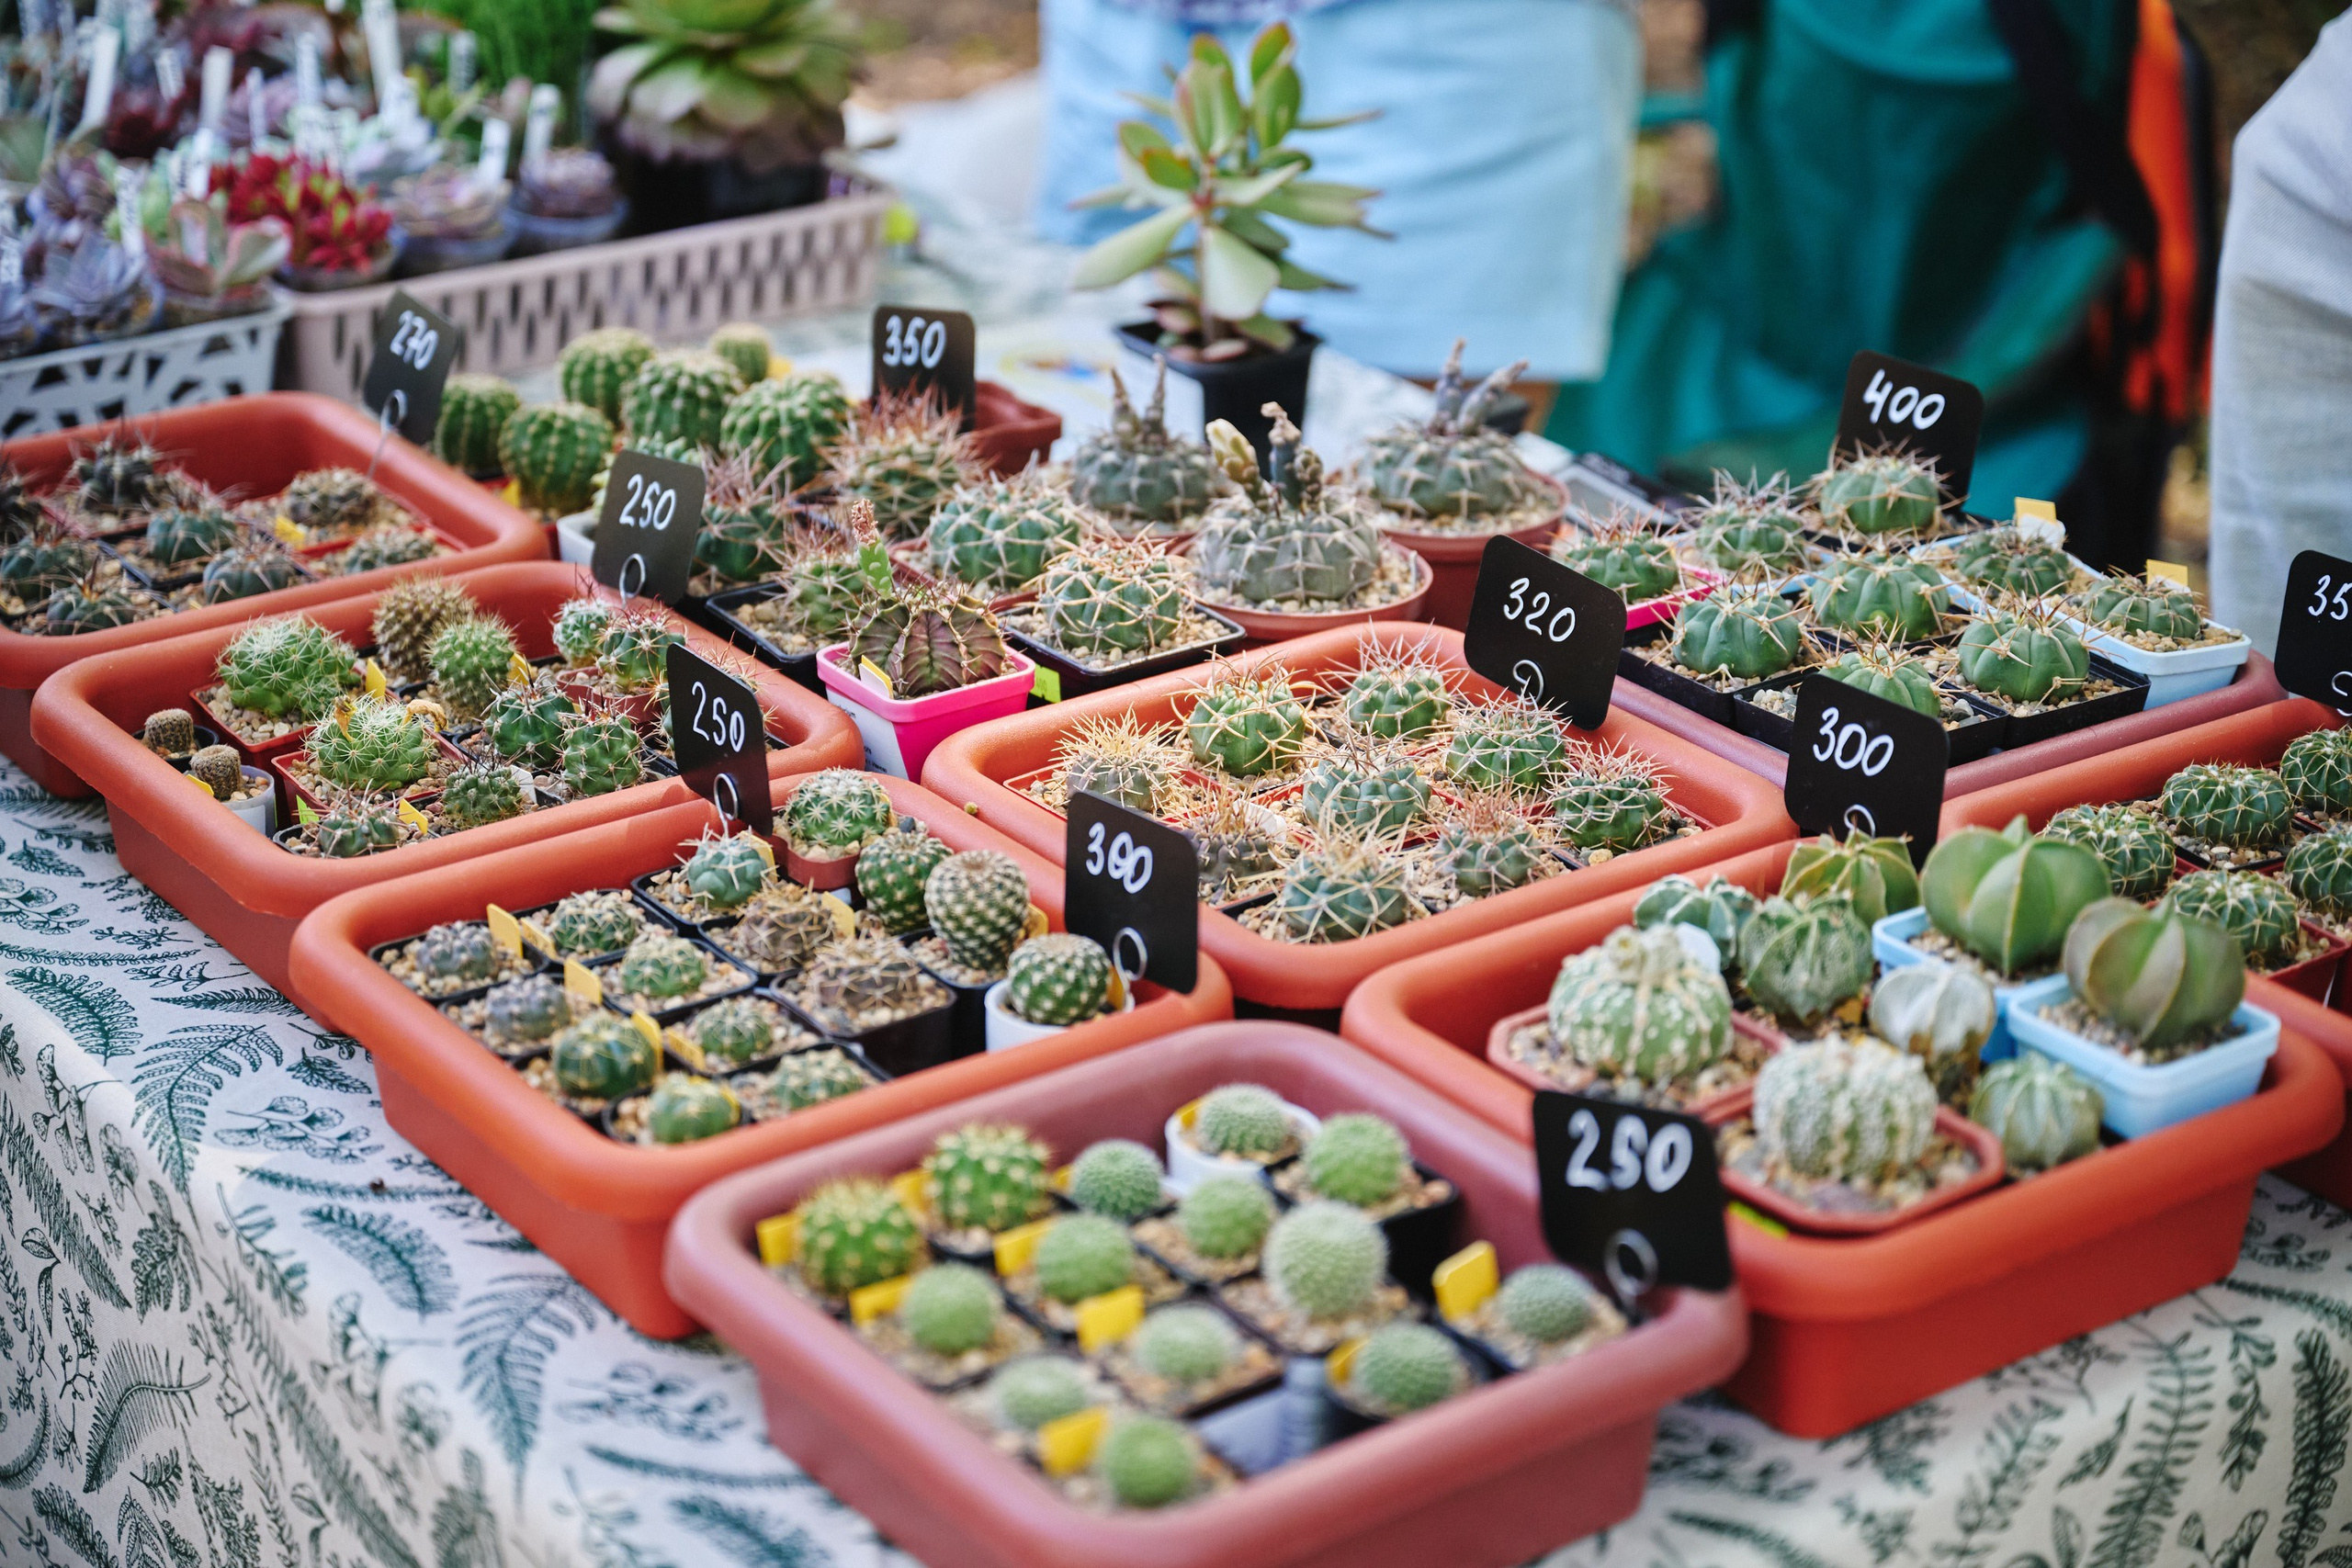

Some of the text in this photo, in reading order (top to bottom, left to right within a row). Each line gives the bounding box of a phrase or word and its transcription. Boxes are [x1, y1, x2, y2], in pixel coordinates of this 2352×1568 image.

[390, 310, 439, 371] 270
[883, 315, 947, 369] 350
[1862, 368, 1946, 431] 400
[619, 474, 677, 530] 250
[1503, 577, 1577, 642] 320
[692, 681, 745, 752] 250
[1813, 706, 1894, 777] 300
[1086, 822, 1153, 894] 300
[1566, 1109, 1693, 1193] 250
